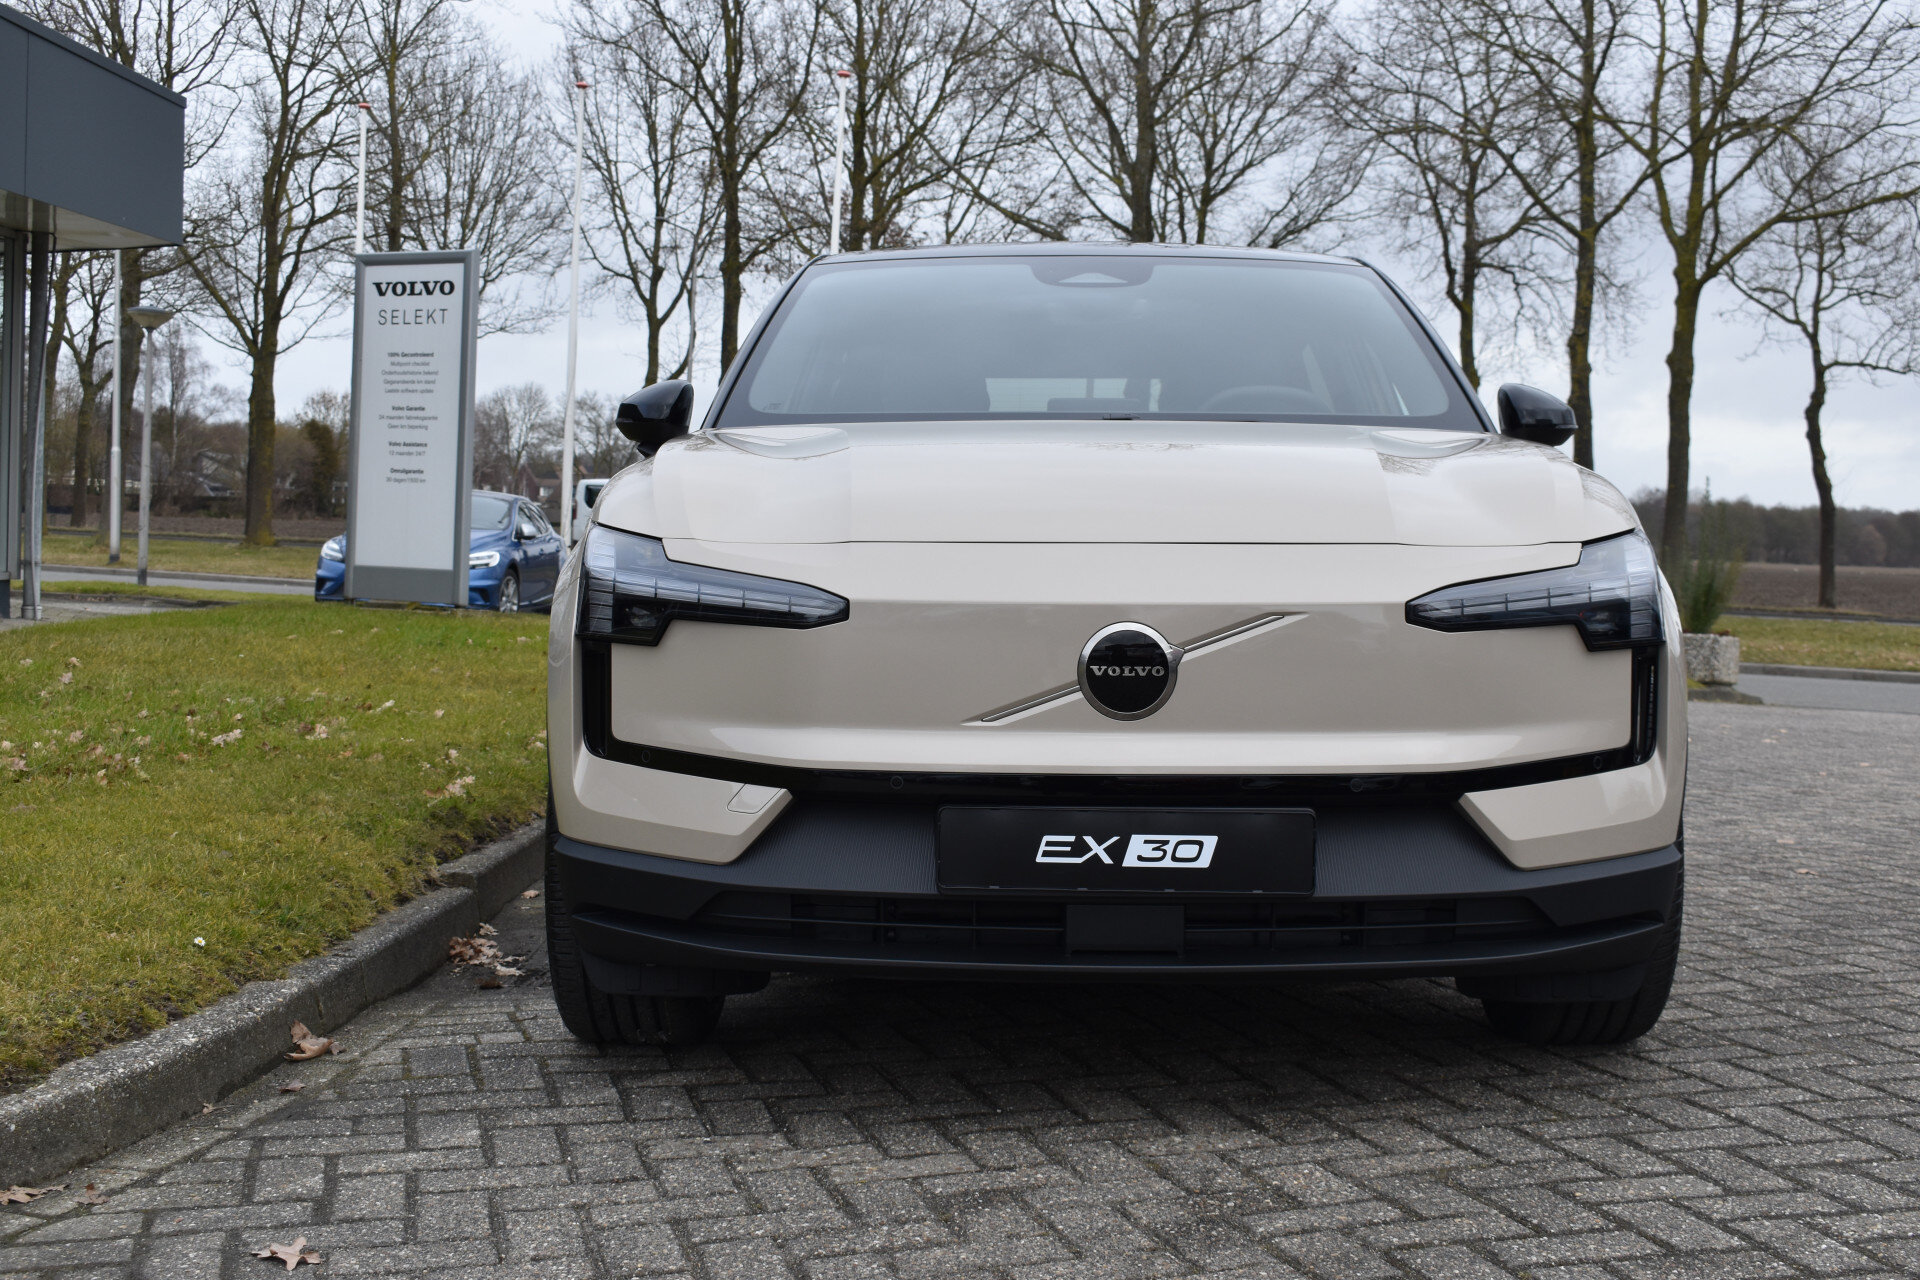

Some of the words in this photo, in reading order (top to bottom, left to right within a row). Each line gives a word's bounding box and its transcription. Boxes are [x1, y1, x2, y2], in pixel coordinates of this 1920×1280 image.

[372, 280, 455, 297] VOLVO
[378, 308, 448, 326] SELEKT
[1089, 665, 1165, 677] VOLVO
